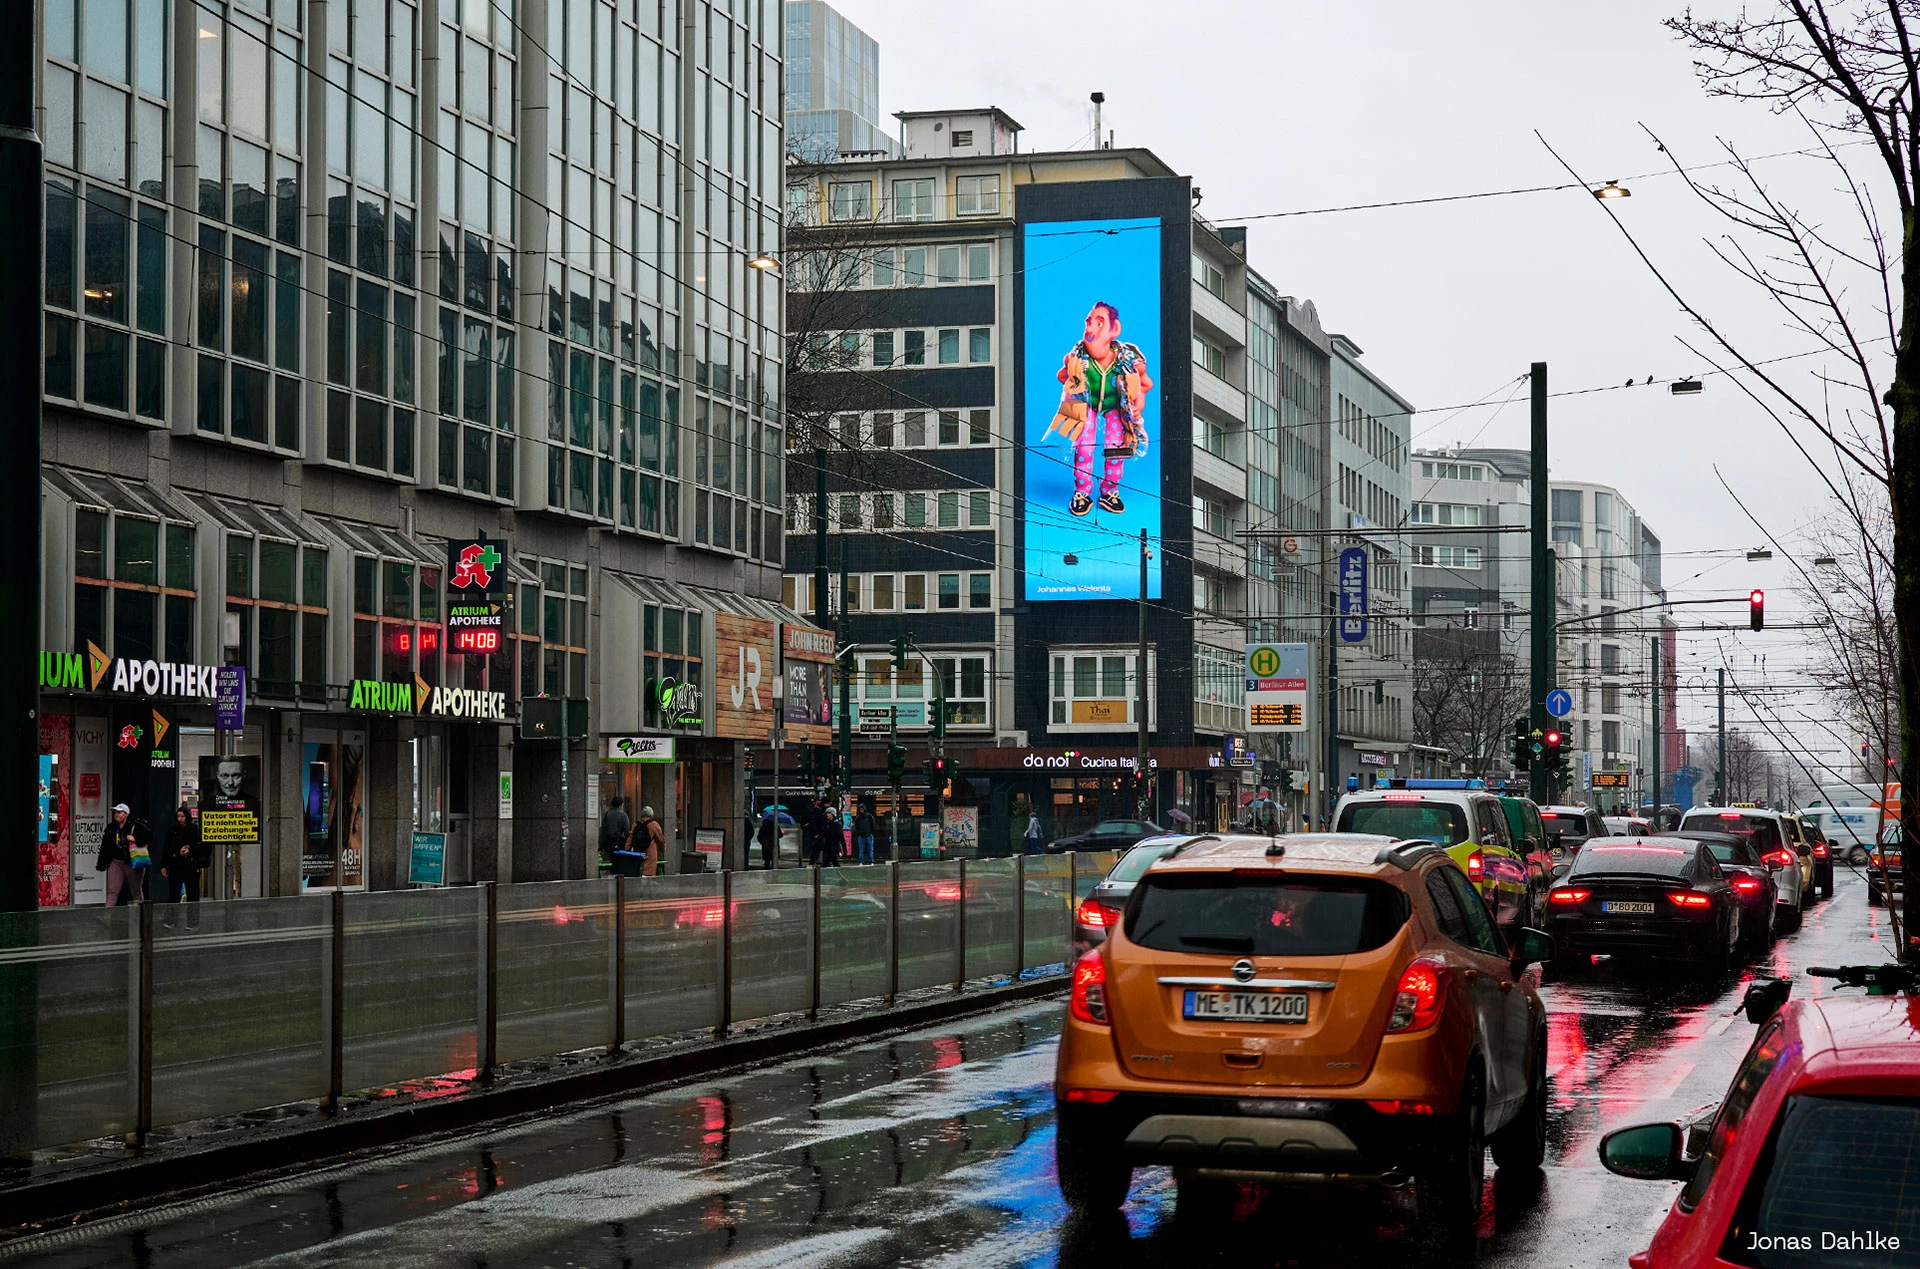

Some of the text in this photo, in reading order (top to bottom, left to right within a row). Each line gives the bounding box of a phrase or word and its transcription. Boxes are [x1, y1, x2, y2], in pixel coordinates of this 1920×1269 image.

[1343, 555, 1362, 633] Berlitz
[450, 606, 489, 616] ATRIUM
[449, 616, 501, 626] APOTHEKE
[461, 633, 496, 648] 14 08
[789, 629, 835, 655] JOHN REED
[39, 651, 84, 689] IUM
[731, 645, 762, 710] JR
[789, 665, 807, 681] MORE
[789, 681, 807, 697] THAN
[1248, 680, 1255, 690] 3
[350, 679, 506, 719] ATRIUM APOTHEKE
[1089, 704, 1110, 715] Thai
[76, 730, 105, 745] VICHY
[151, 750, 170, 759] ATRIUM
[1023, 753, 1157, 768] da noi Cucina Italia
[151, 759, 175, 768] APOTHEKE
[414, 835, 428, 843] WIR
[74, 844, 101, 855] SPECIALIS
[341, 848, 361, 865] 48H
[1607, 902, 1653, 912] D BO 2001
[1196, 994, 1305, 1017] ME TK 1200
